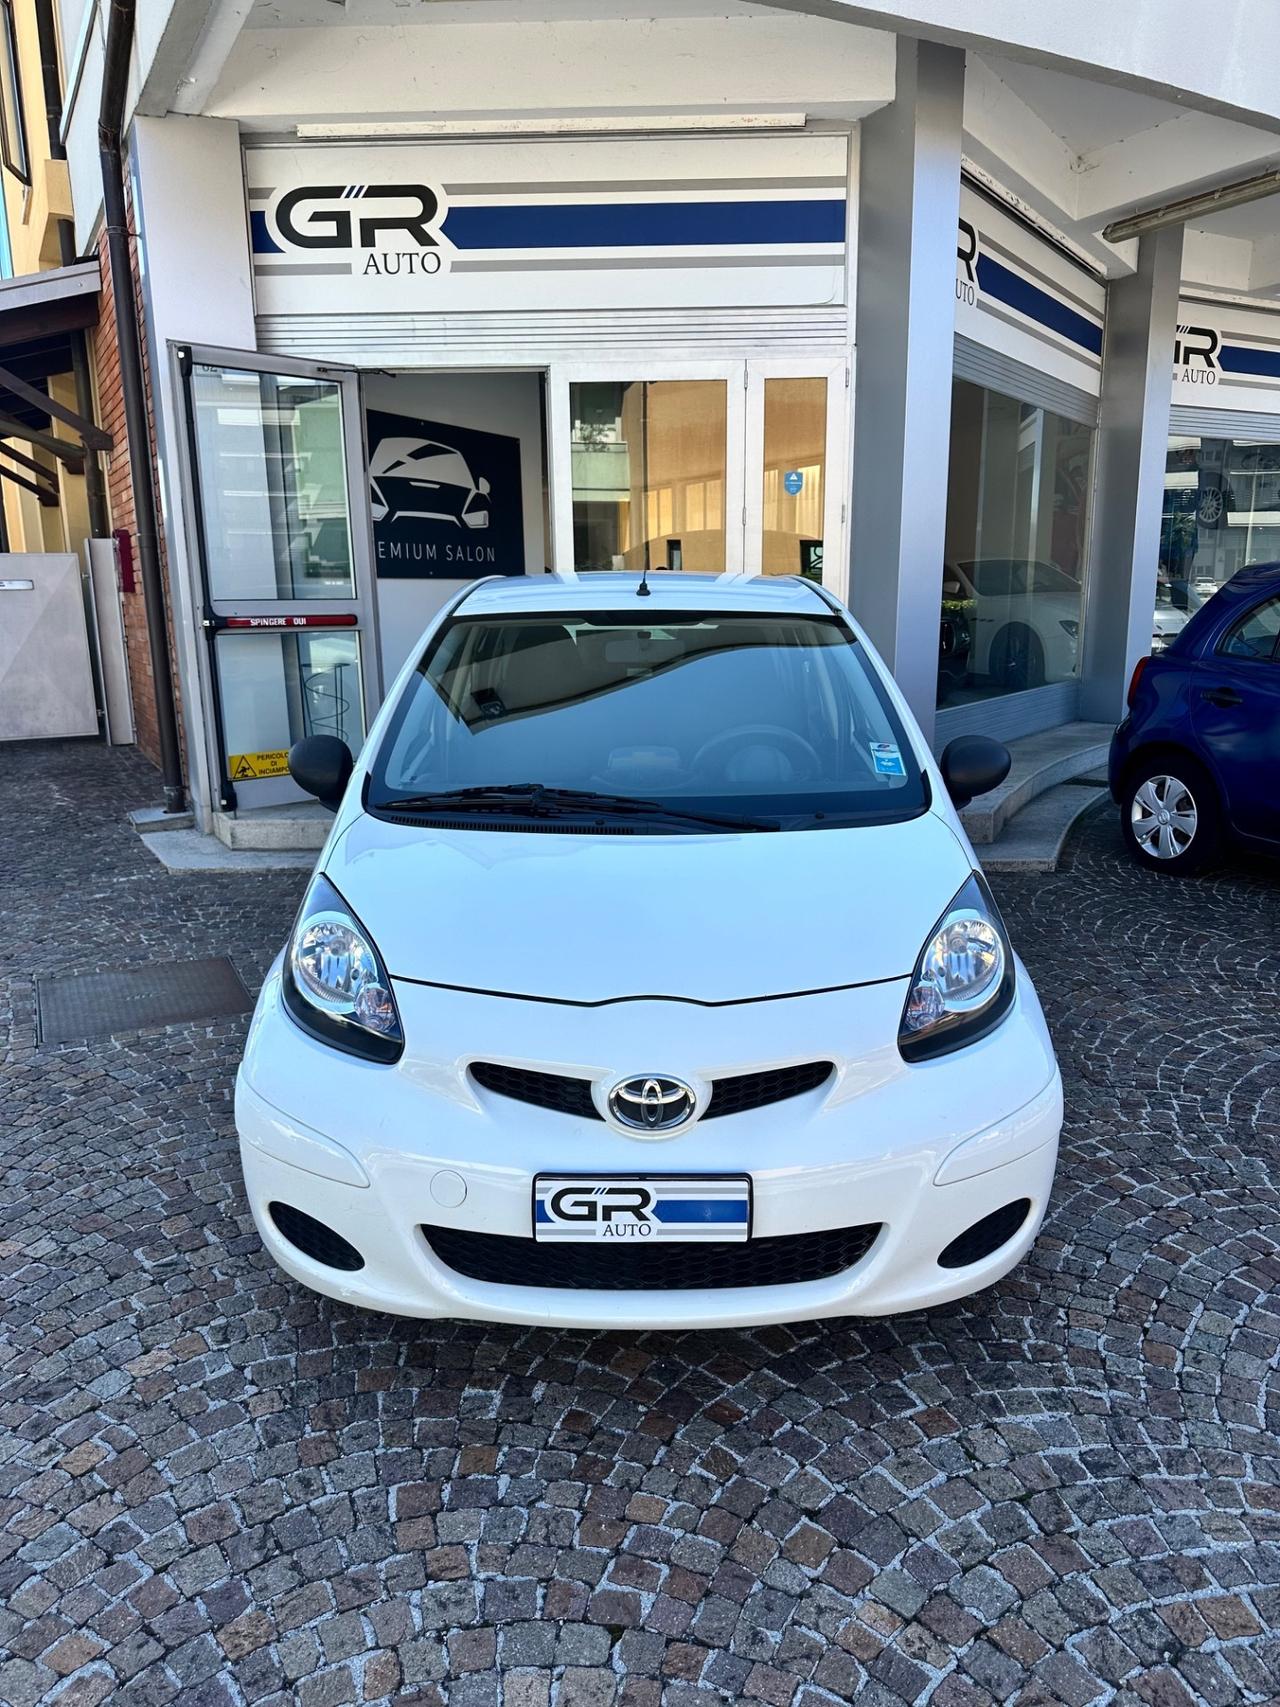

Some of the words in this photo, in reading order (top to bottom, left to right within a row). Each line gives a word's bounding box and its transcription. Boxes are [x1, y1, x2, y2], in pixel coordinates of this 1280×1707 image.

[276, 184, 439, 249] GR
[957, 217, 977, 283] R
[363, 251, 442, 276] AUTO
[956, 278, 975, 306] UTO
[1181, 368, 1216, 385] AUTO
[377, 541, 437, 560] EMIUM
[446, 544, 496, 562] SALON
[249, 617, 287, 627] SPINGERE
[550, 1187, 651, 1222] GR
[602, 1224, 652, 1237] AUTO
